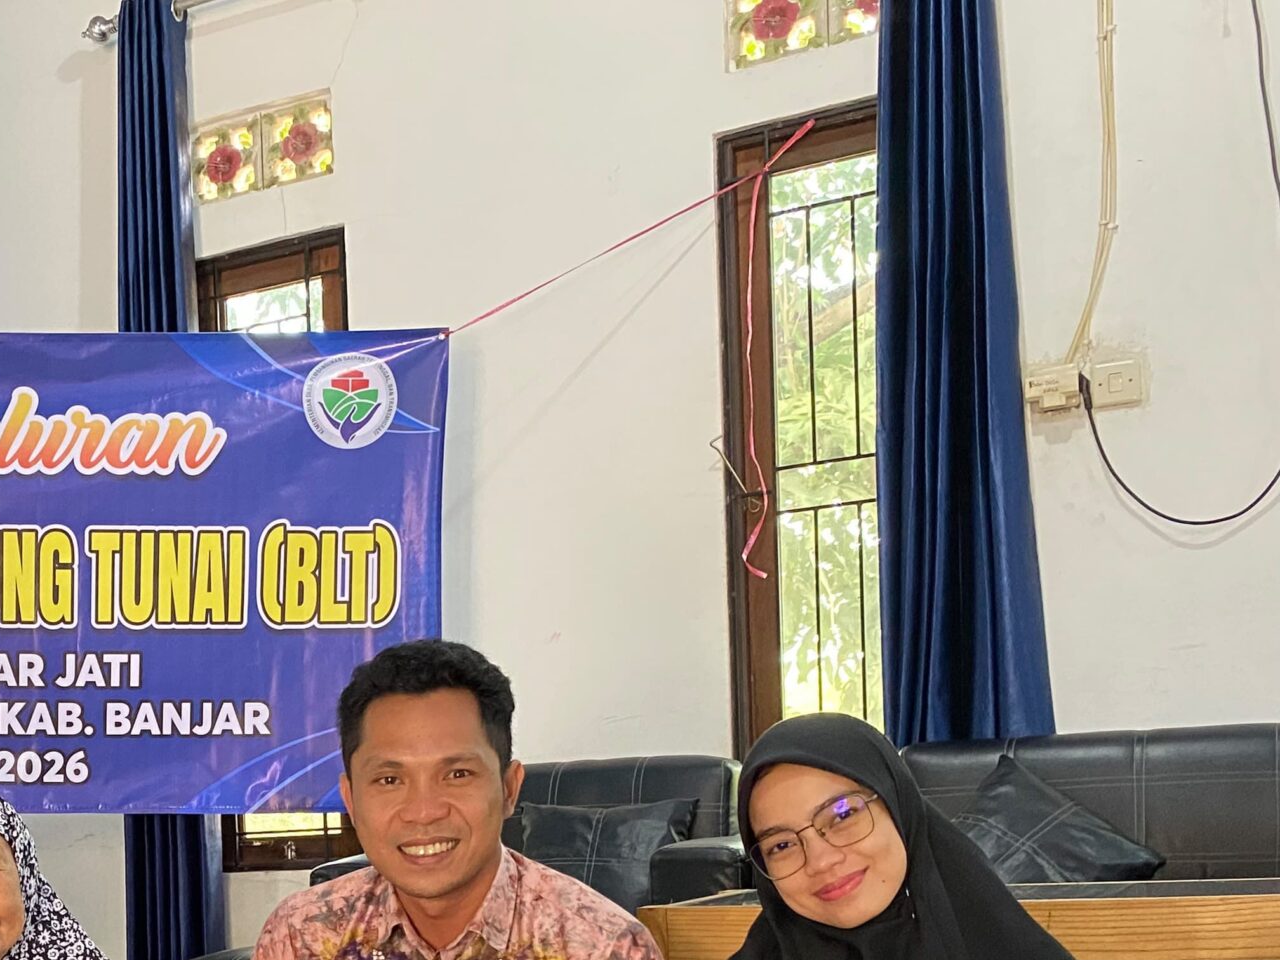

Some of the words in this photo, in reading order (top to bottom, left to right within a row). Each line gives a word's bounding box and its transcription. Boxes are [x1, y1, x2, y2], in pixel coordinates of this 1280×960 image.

[87, 527, 249, 628] TUNAI
[259, 520, 400, 628] (BLT)
[55, 653, 140, 687] JATI
[106, 702, 271, 735] BANJAR
